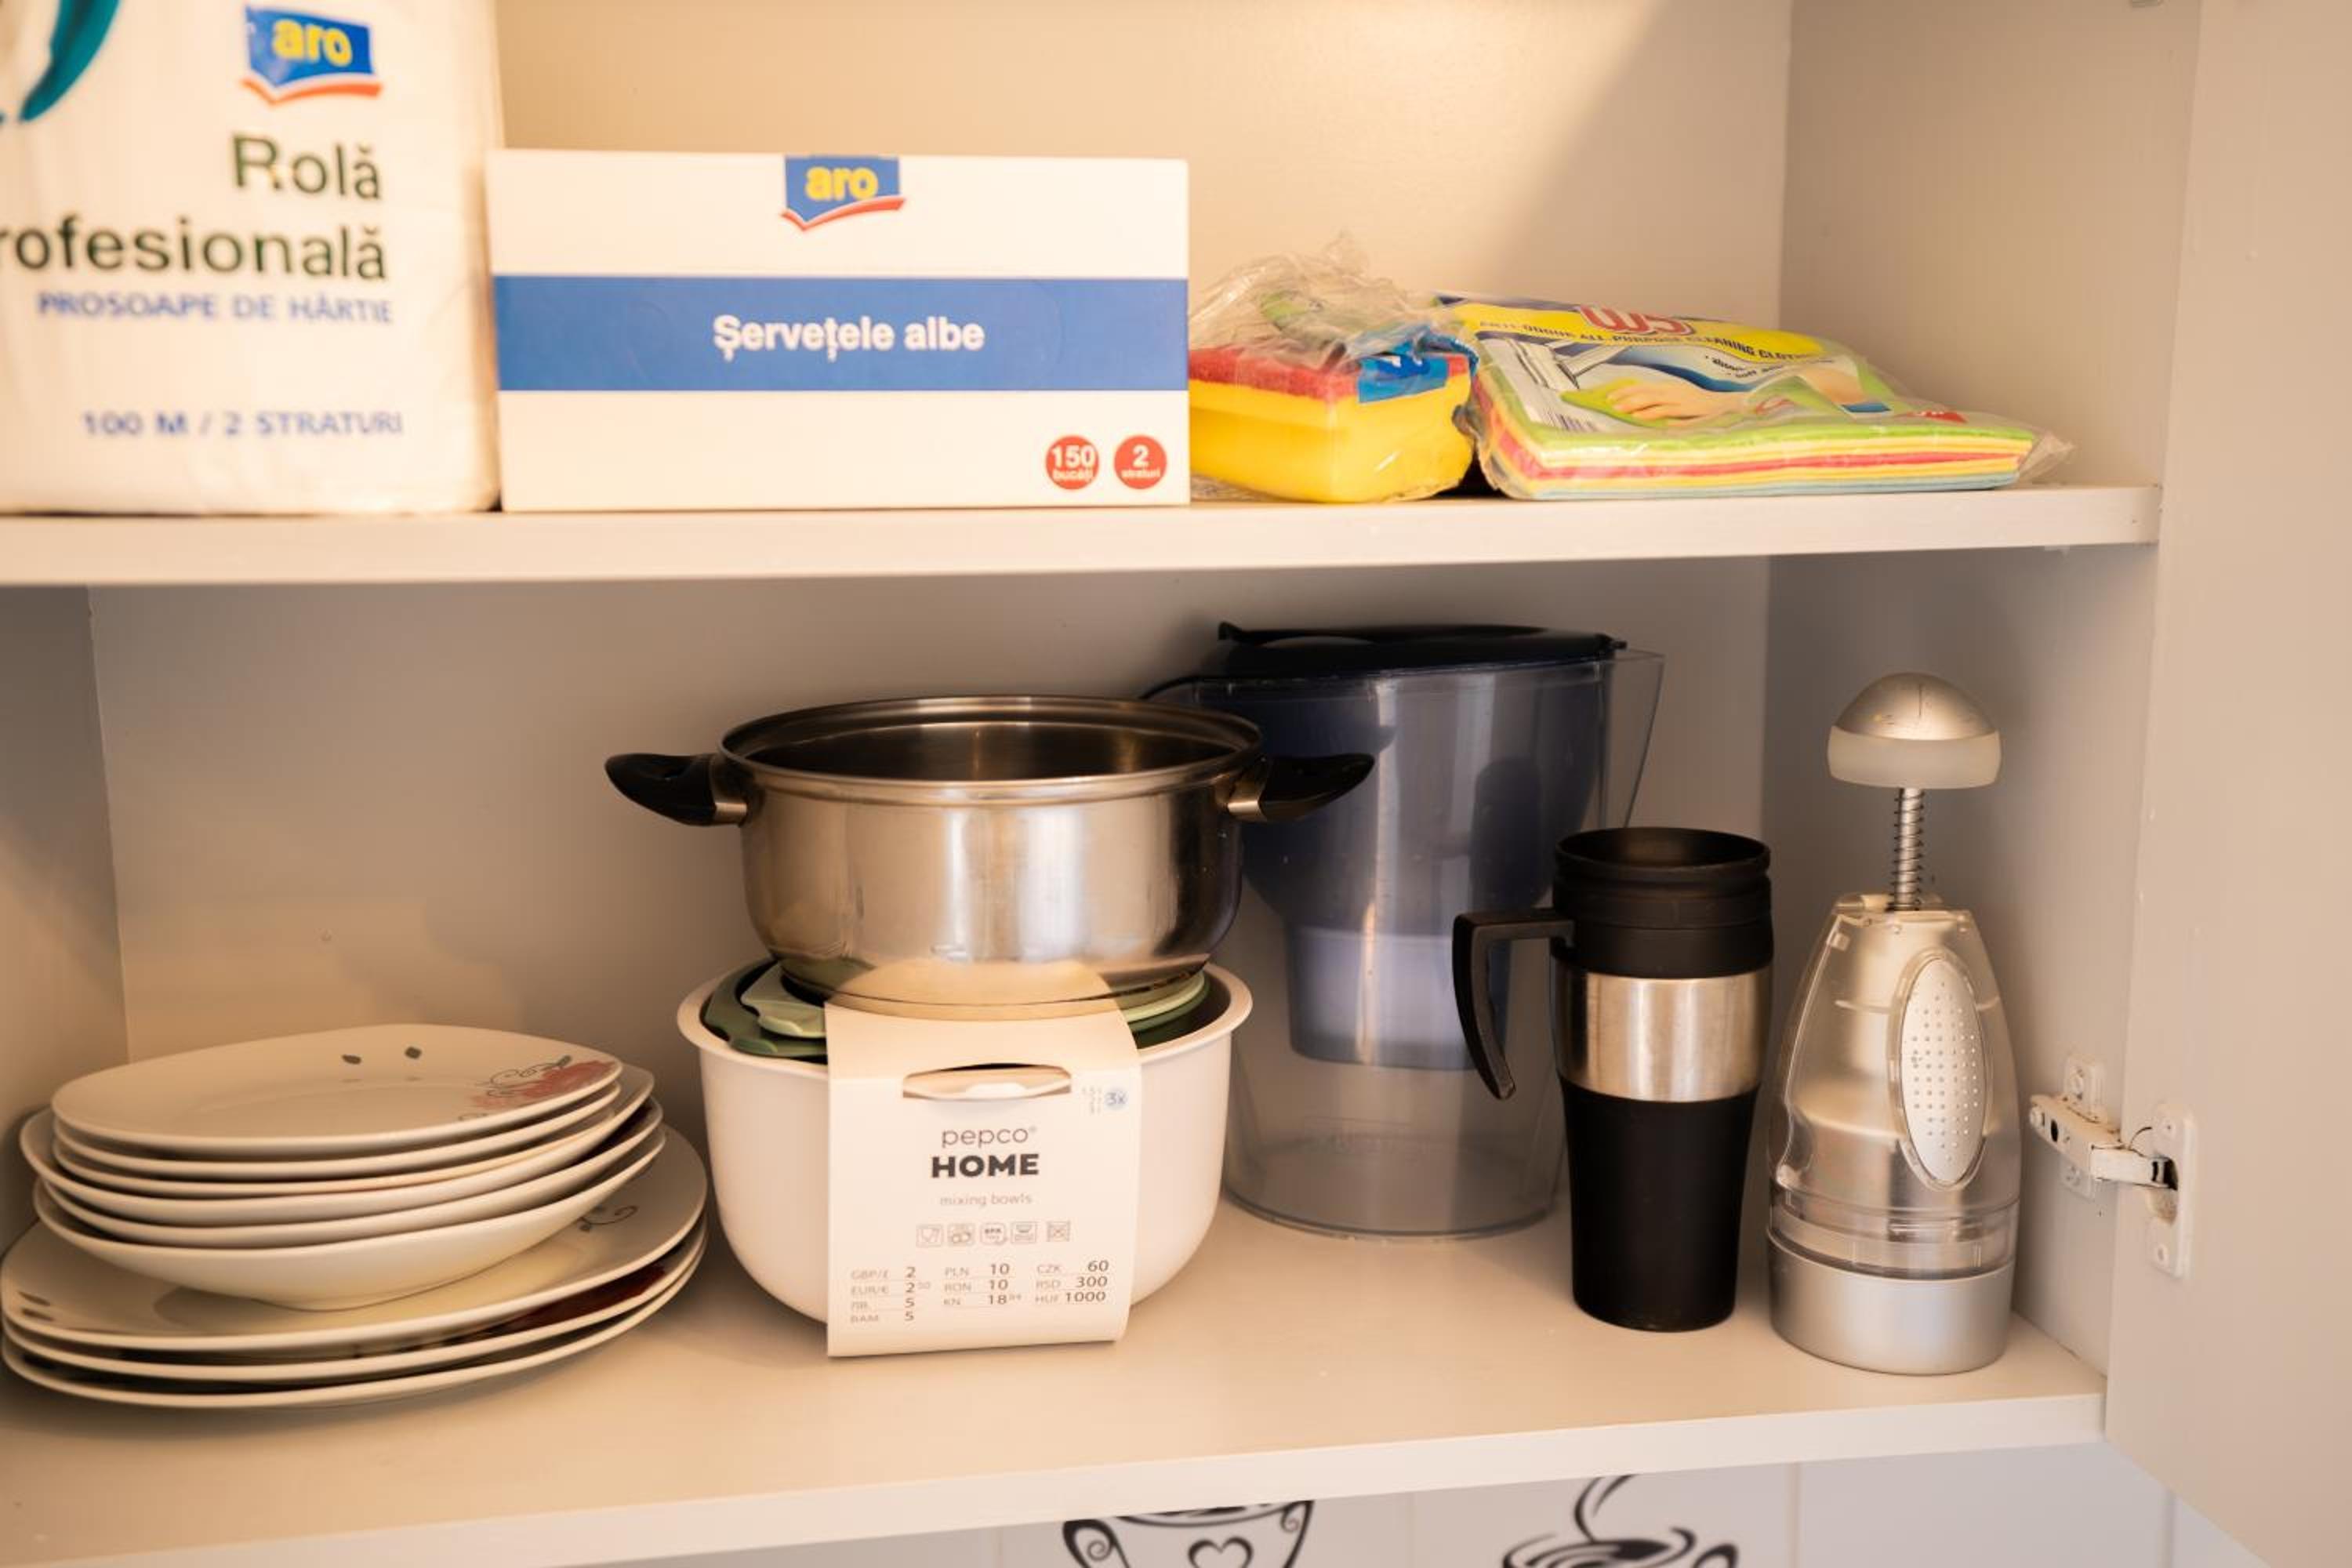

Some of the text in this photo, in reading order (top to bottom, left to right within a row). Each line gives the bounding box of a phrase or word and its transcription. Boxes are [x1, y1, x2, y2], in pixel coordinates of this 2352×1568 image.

[271, 19, 353, 67] aro
[232, 133, 382, 201] Rolă
[805, 165, 878, 201] aro
[37, 291, 217, 319] PROSOAPE
[234, 294, 276, 318] DE
[903, 315, 985, 351] albe
[81, 411, 403, 437] 100 M / 2 STRATURI
[1051, 445, 1096, 468] 150
[1131, 445, 1149, 468] 2
[931, 1153, 1040, 1178] HOME
[939, 1192, 1033, 1209] mixing bowls
[906, 1266, 916, 1278] 2
[943, 1263, 1011, 1277] PLN 10
[1036, 1259, 1109, 1274] CZK 60
[943, 1279, 1010, 1292] RON 10
[1076, 1276, 1109, 1288] 300
[905, 1298, 915, 1308] 5
[1065, 1291, 1107, 1303] 1000
[904, 1311, 915, 1322] 5
